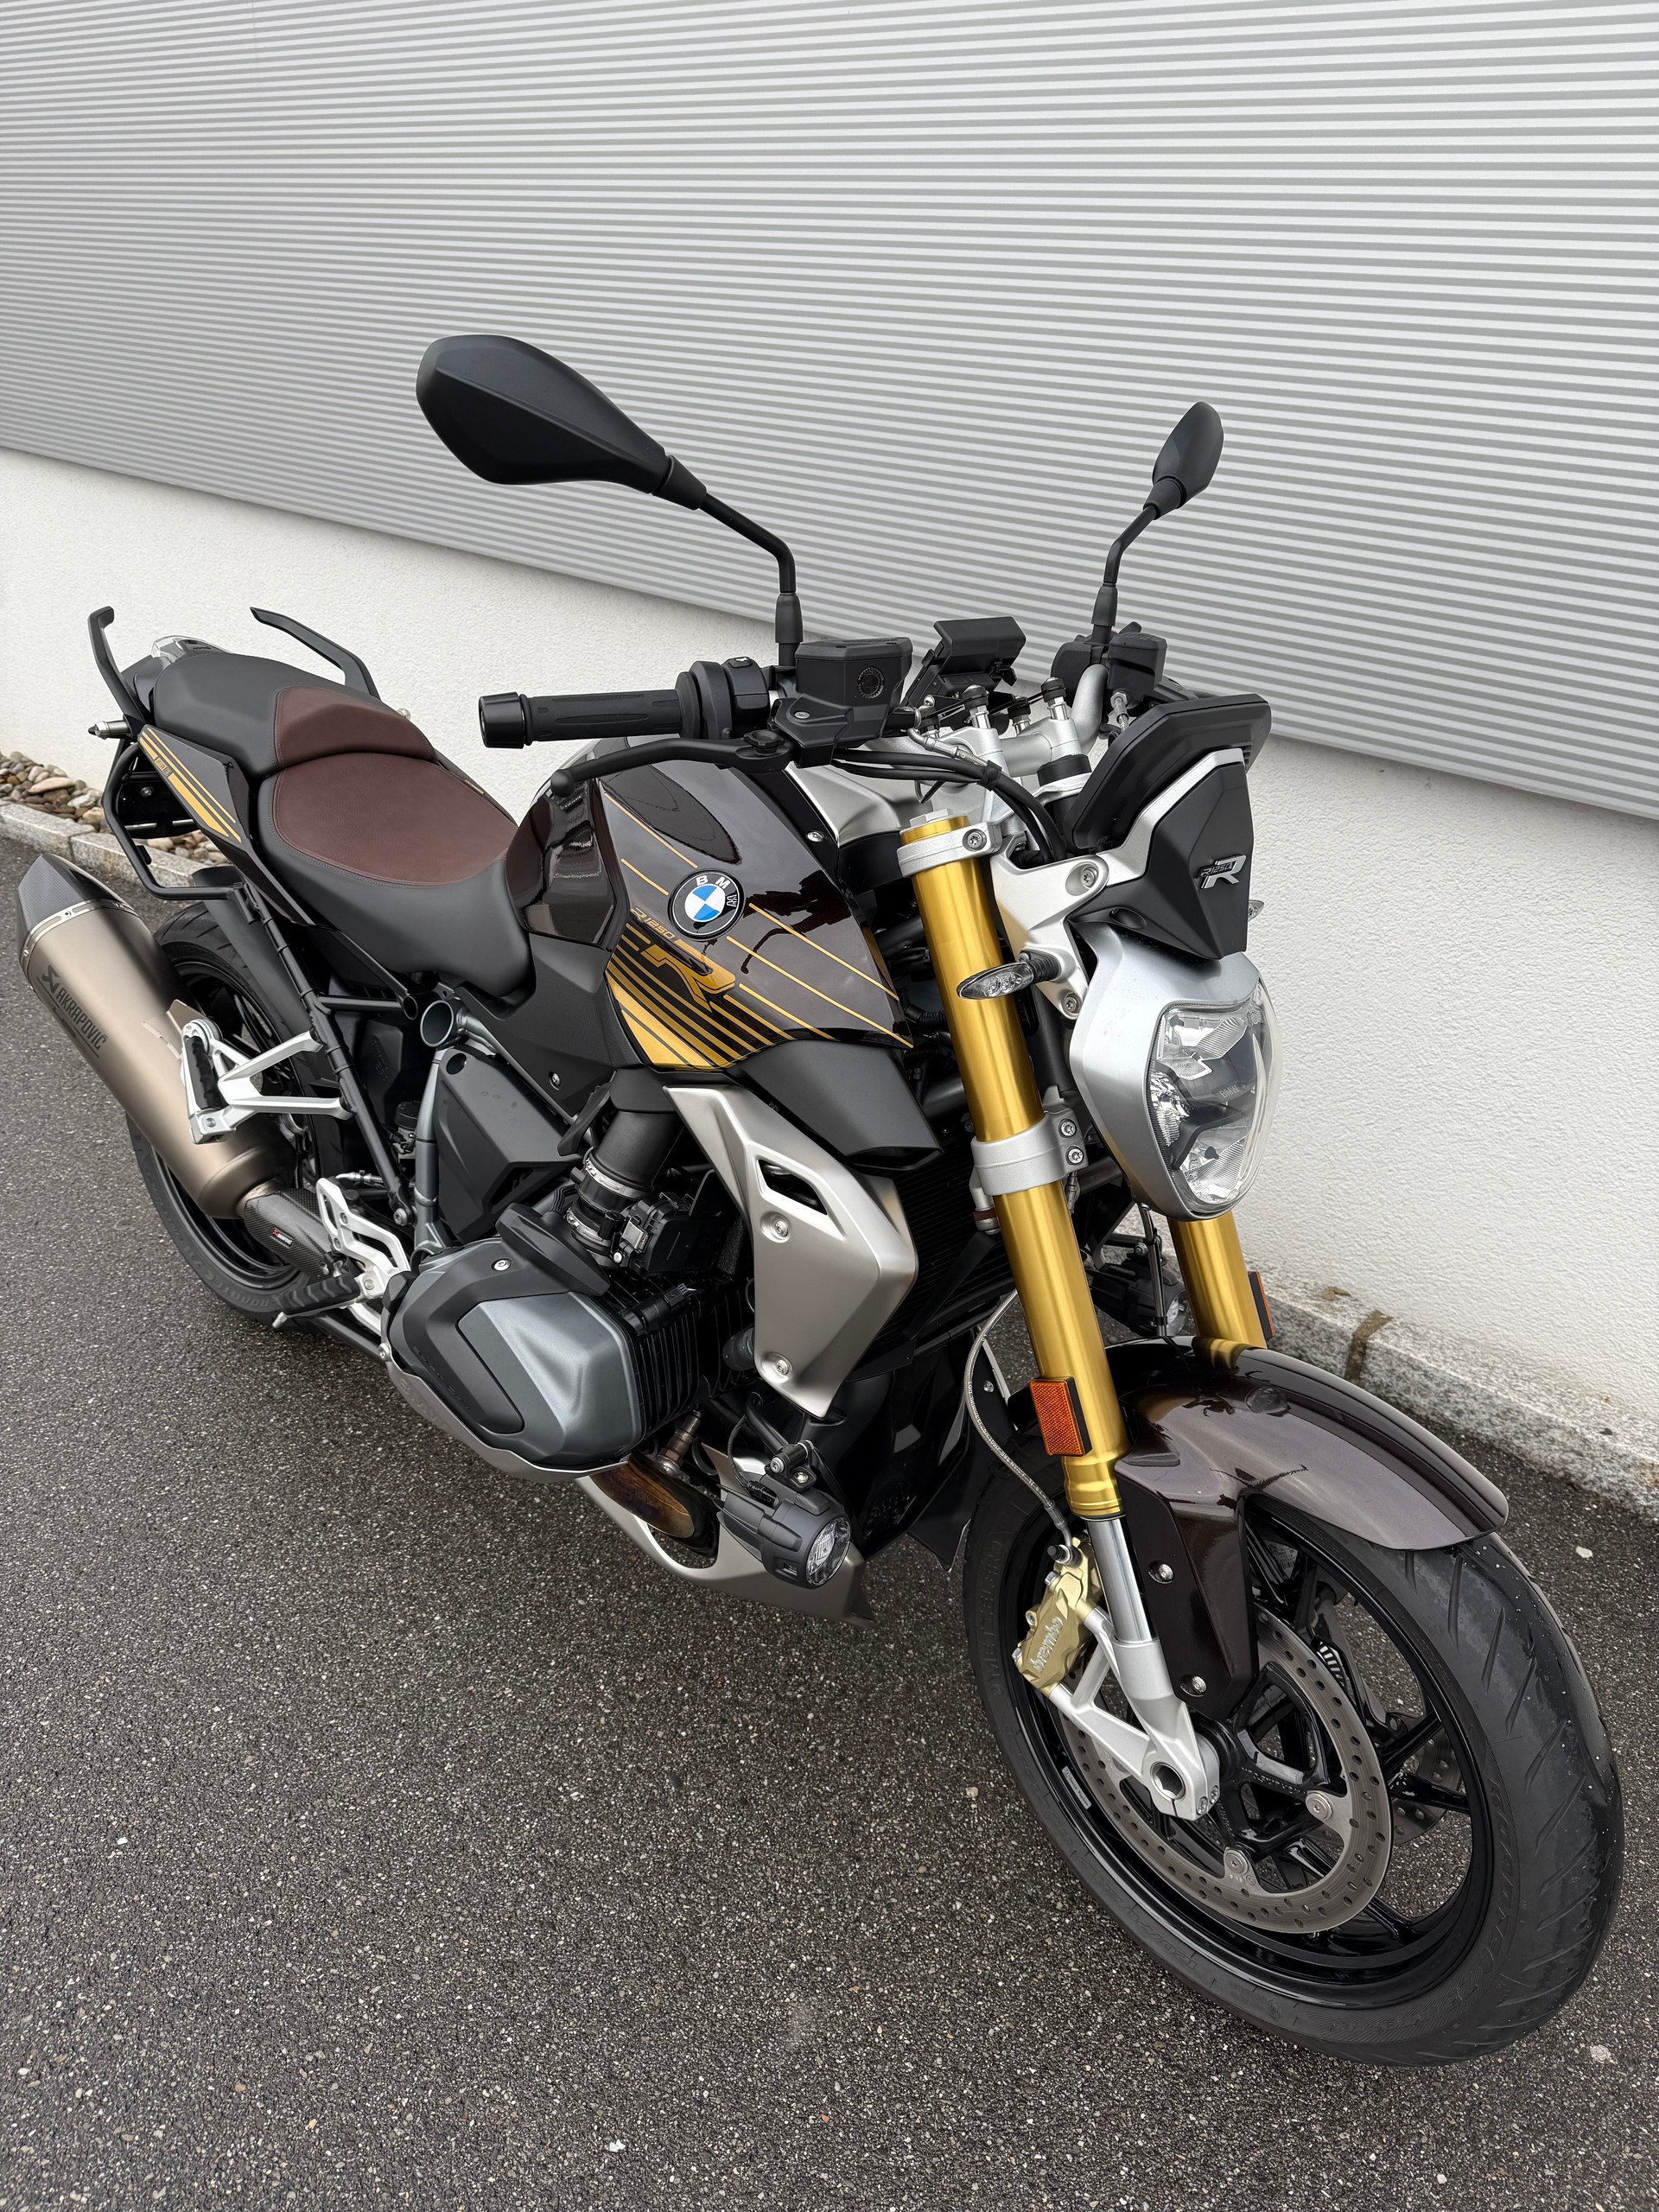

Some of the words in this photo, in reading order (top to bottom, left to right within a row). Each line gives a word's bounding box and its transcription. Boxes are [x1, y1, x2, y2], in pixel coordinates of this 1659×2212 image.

[696, 874, 738, 907] BMW
[630, 907, 677, 940] R1250
[55, 987, 109, 1051] AKRAPOVIČ
[1218, 1084, 1240, 1098] BMW
[1030, 1616, 1064, 1674] brembo
